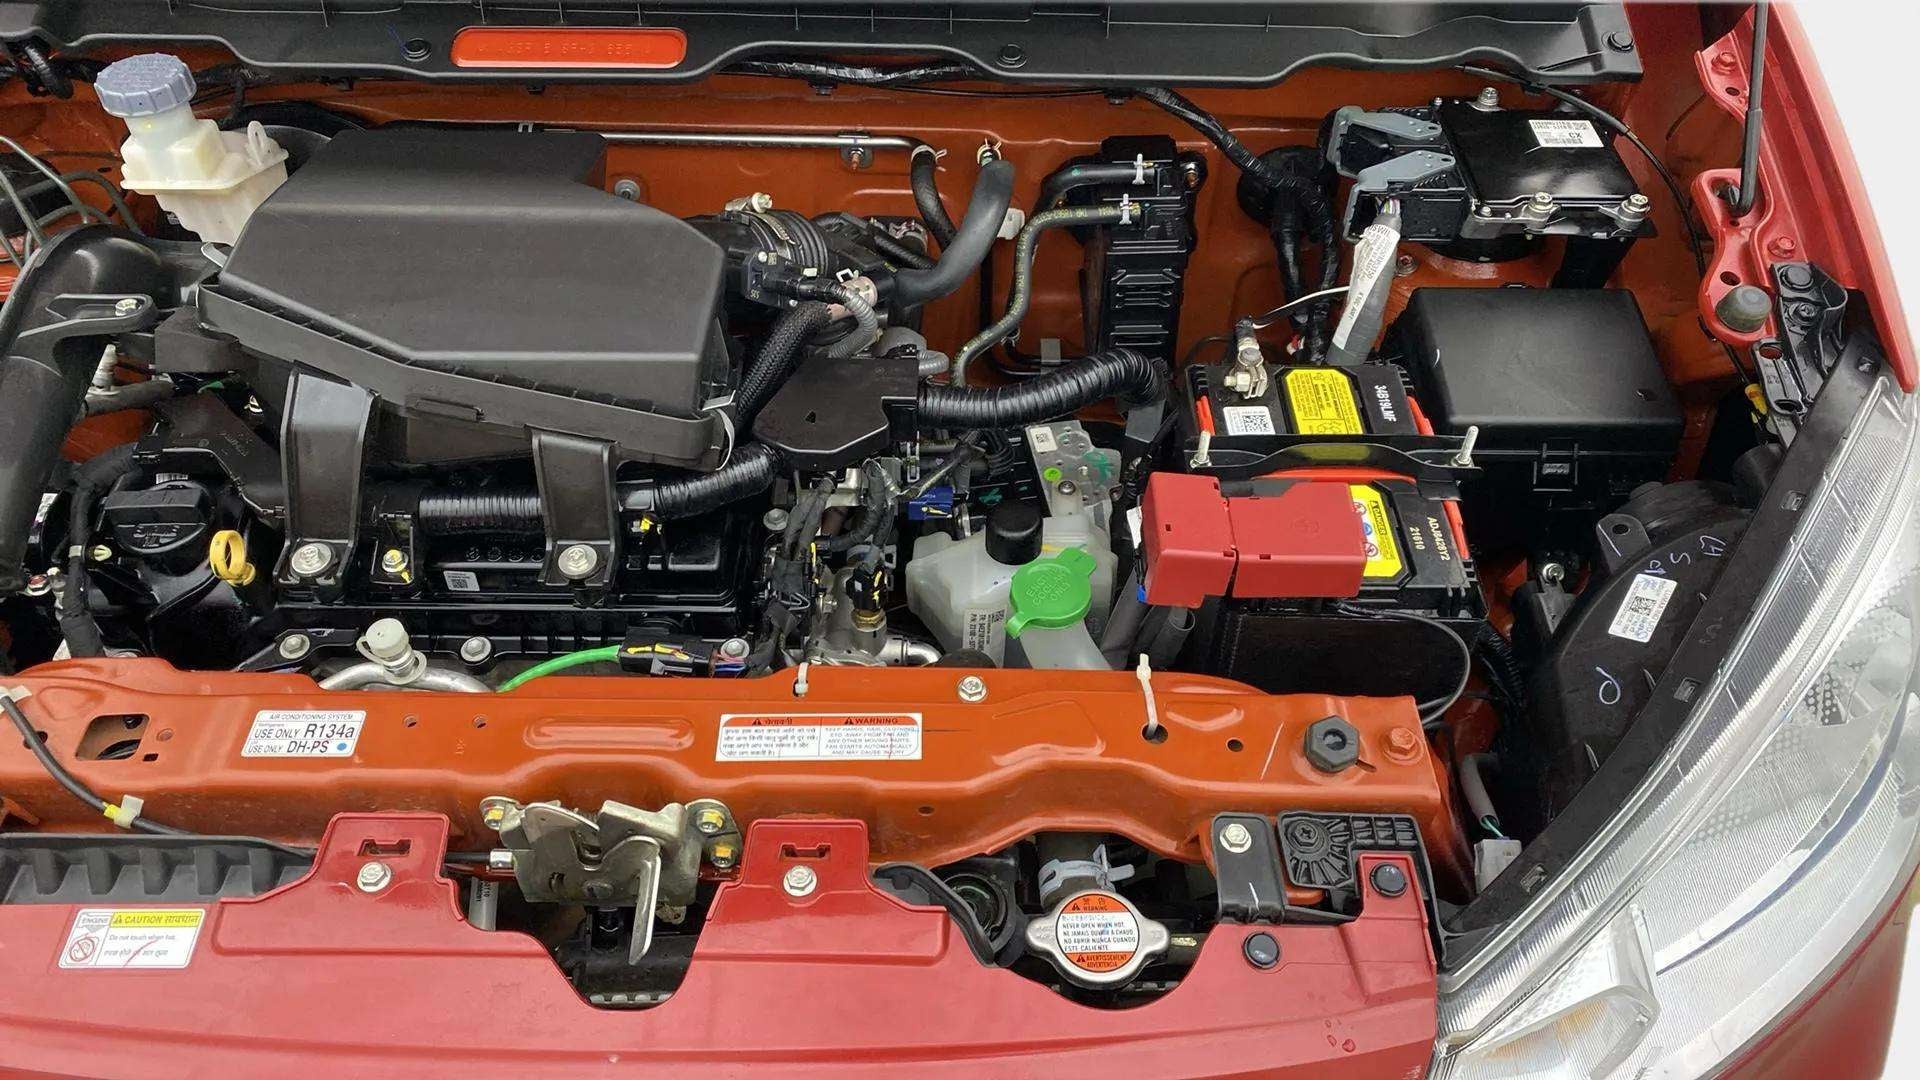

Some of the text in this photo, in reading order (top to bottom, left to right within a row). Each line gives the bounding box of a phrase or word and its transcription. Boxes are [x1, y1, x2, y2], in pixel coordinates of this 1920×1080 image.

[1374, 385, 1397, 423] 34B19LMF
[254, 723, 355, 739] USE ONLY R134a
[248, 740, 329, 753] USE ONLY DH-PS
[124, 916, 162, 924] CAUTION
